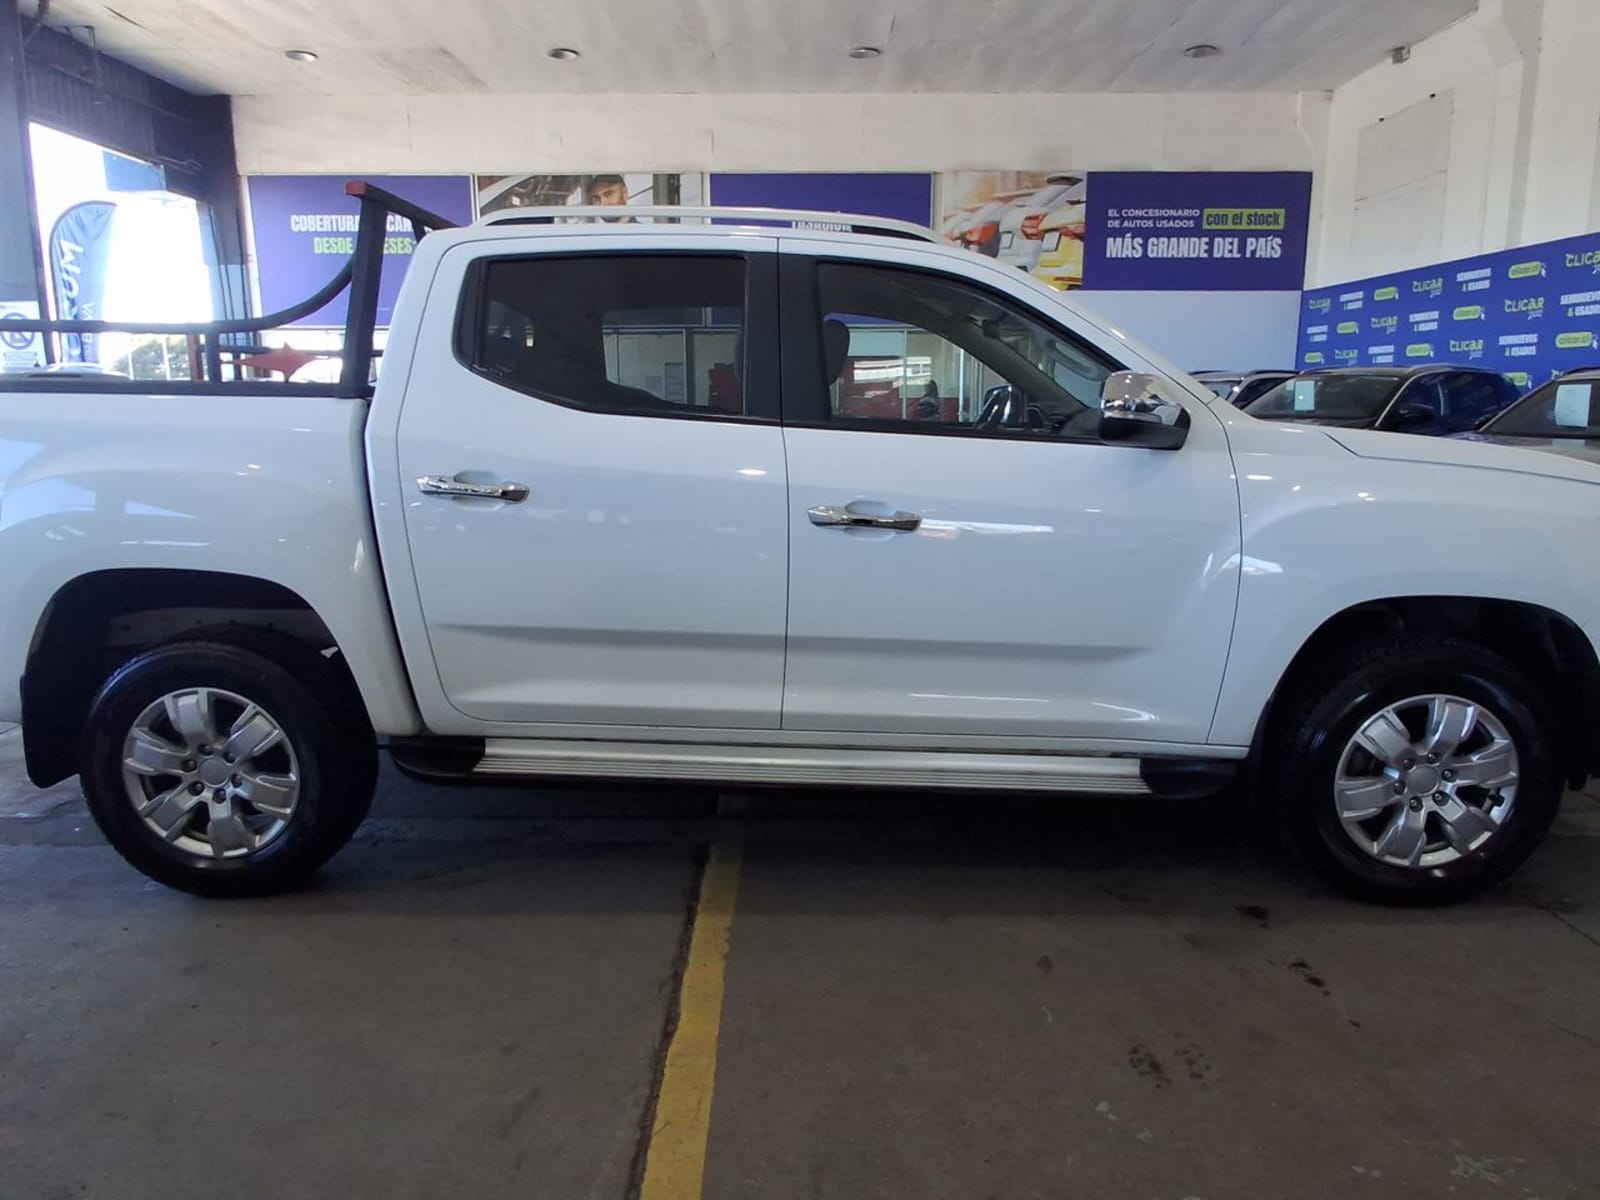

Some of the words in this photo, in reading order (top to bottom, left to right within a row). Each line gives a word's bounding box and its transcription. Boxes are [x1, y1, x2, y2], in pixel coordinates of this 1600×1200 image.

[1108, 209, 1119, 217] EL
[1121, 208, 1200, 217] CONCESIONARIO
[1206, 213, 1228, 226] con
[1232, 211, 1243, 226] el
[1246, 211, 1281, 226] stock
[1107, 220, 1120, 228] DE
[1122, 219, 1154, 228] AUTOS
[1155, 219, 1195, 228] USADOS
[313, 237, 353, 254] DESDE
[383, 237, 413, 254] ESES
[1106, 232, 1143, 258] MÁS
[1147, 237, 1209, 258] GRANDE
[1213, 237, 1241, 258] DEL
[1245, 235, 1282, 258] PAÍS
